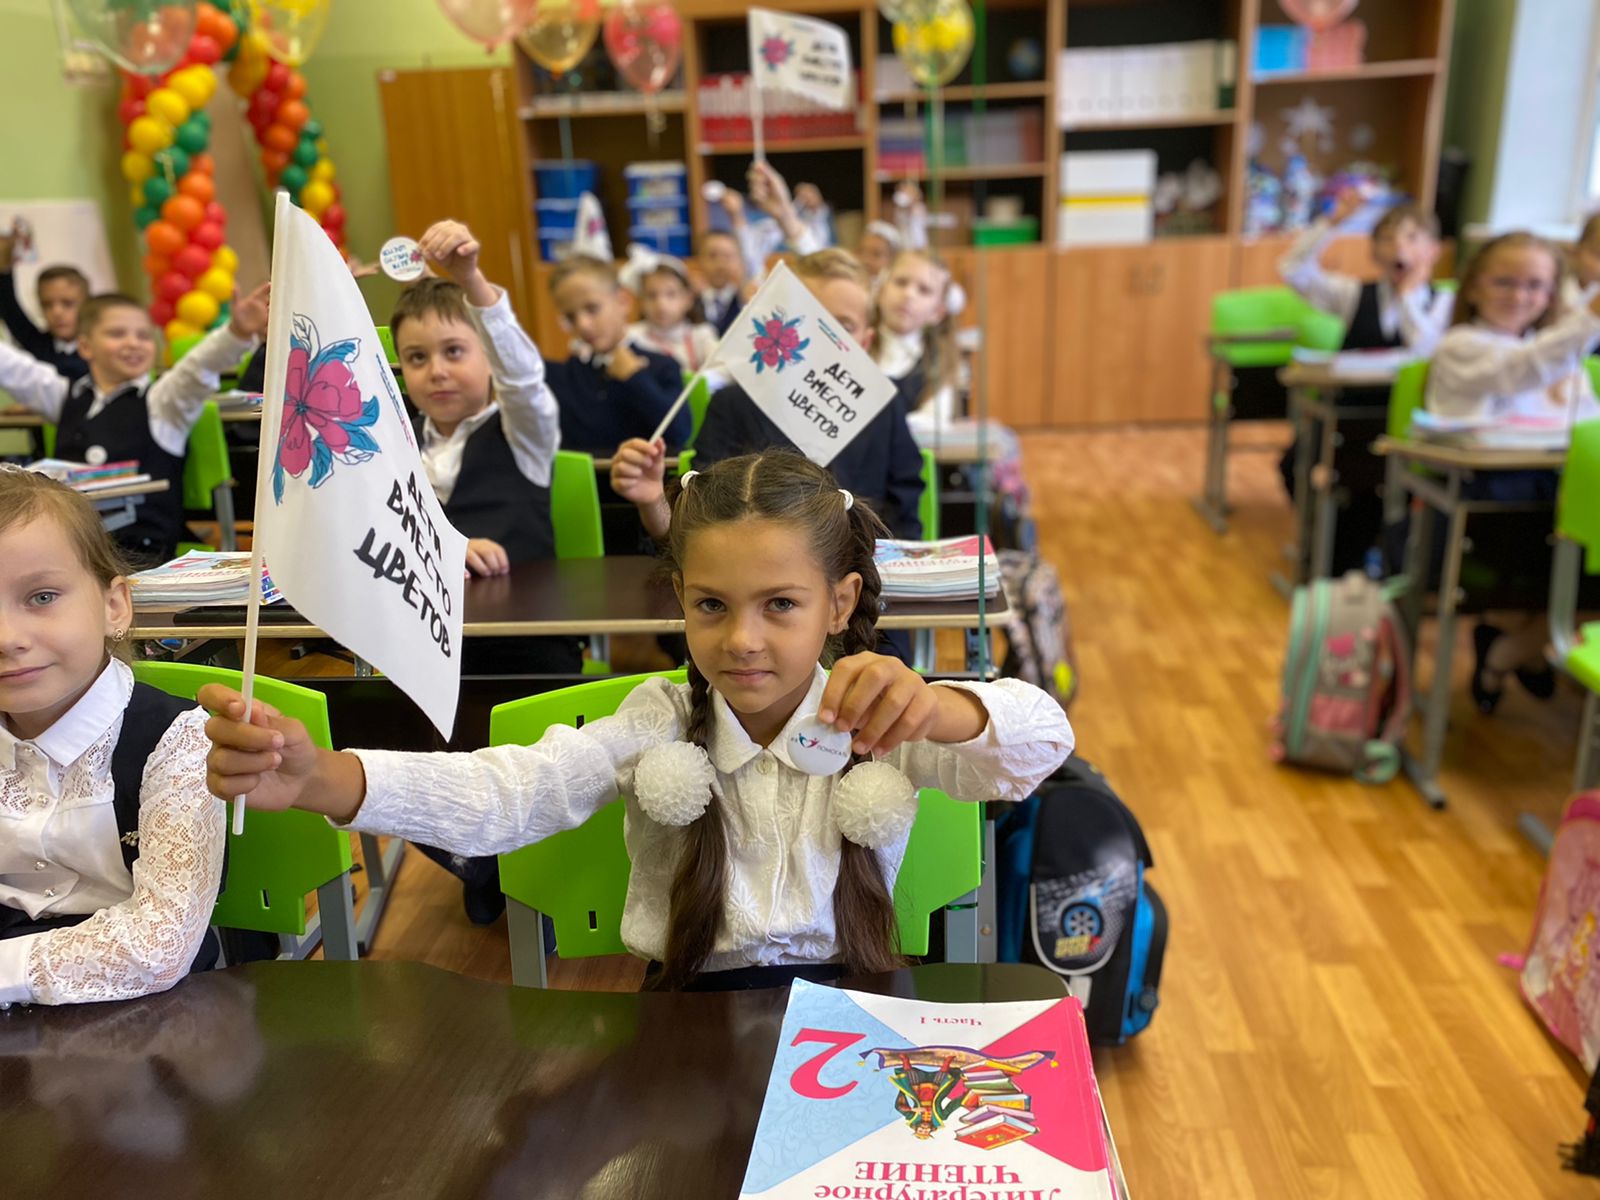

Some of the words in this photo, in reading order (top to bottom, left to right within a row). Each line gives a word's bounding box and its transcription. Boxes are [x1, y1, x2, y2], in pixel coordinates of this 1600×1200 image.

[803, 369, 857, 423] ВМЕСТО
[823, 362, 865, 400] ДЕТИ
[787, 388, 840, 439] ЦВЕТОВ
[406, 470, 442, 561] ДЕТИ
[386, 478, 451, 616] ВМЕСТО
[352, 526, 452, 658] ЦВЕТОВ
[932, 1016, 983, 1026] Часть
[789, 1027, 867, 1100] 2
[855, 1160, 1023, 1185] ЧТЕНИЕ
